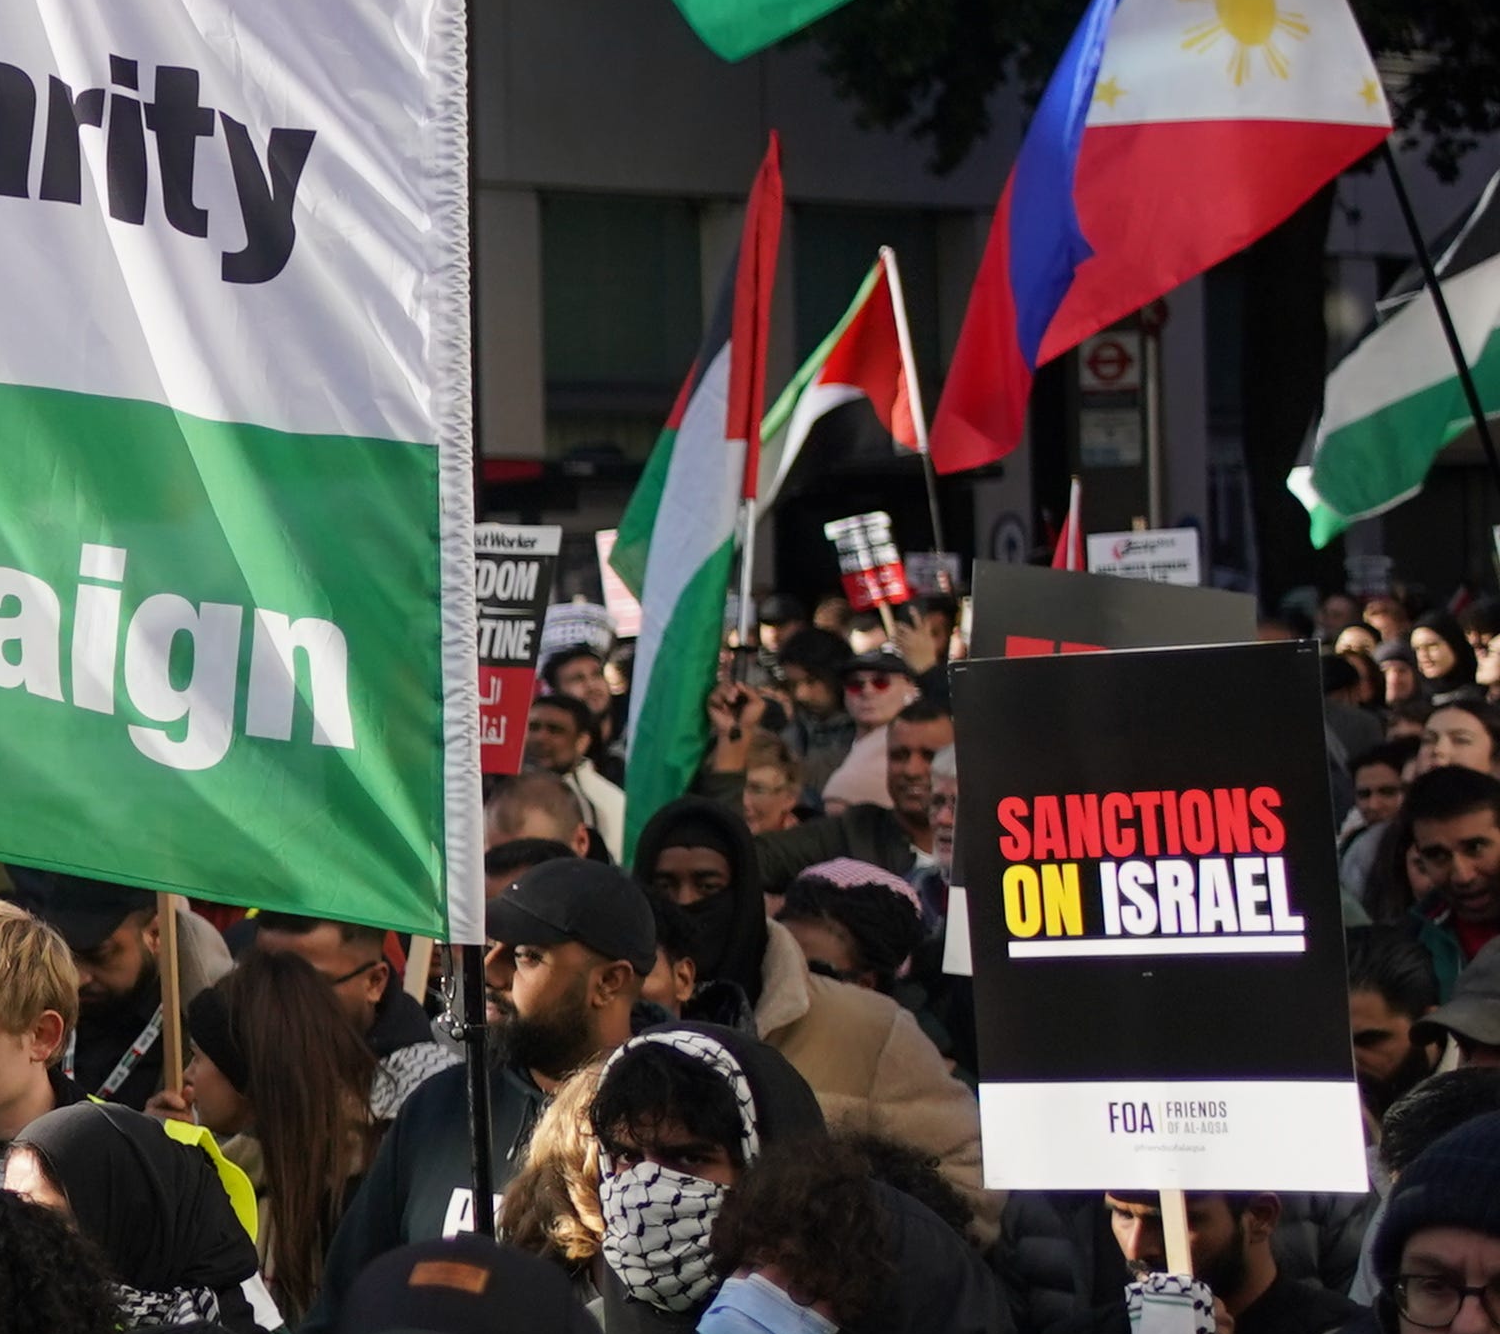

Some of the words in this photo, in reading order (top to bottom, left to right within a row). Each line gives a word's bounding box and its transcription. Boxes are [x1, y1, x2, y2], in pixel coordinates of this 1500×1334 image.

[475, 559, 540, 601] DOM
[997, 785, 1286, 863] SANCTIONS
[1003, 863, 1084, 940] ON
[1099, 855, 1305, 936] ISRAEL
[1108, 1101, 1155, 1134] FOA
[1165, 1100, 1228, 1119] FRIENDS
[1167, 1121, 1181, 1135] OF
[1183, 1120, 1229, 1135] AL-AQSA
